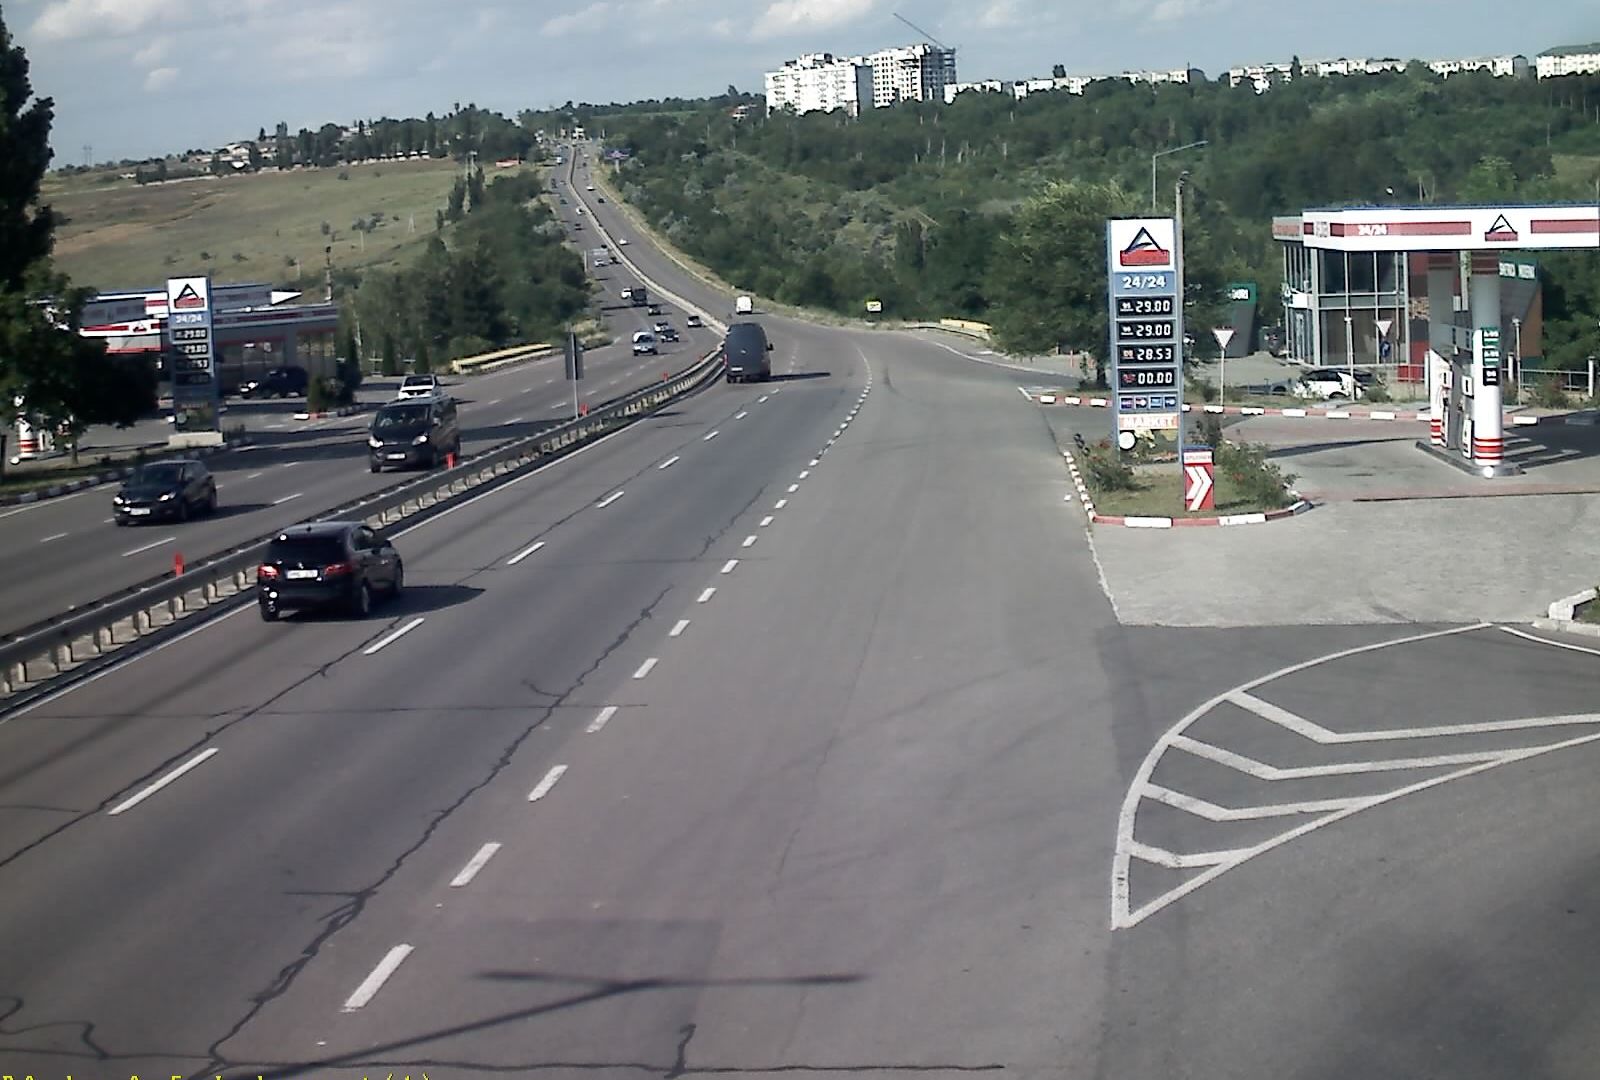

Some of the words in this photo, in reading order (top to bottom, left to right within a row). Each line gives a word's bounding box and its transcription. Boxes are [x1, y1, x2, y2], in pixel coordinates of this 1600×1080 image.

[1122, 275, 1166, 289] 24/24
[1135, 300, 1170, 312] 29.00
[1136, 324, 1171, 336] 29.00
[1137, 348, 1172, 360] 28.53
[1137, 372, 1173, 384] 00.00
